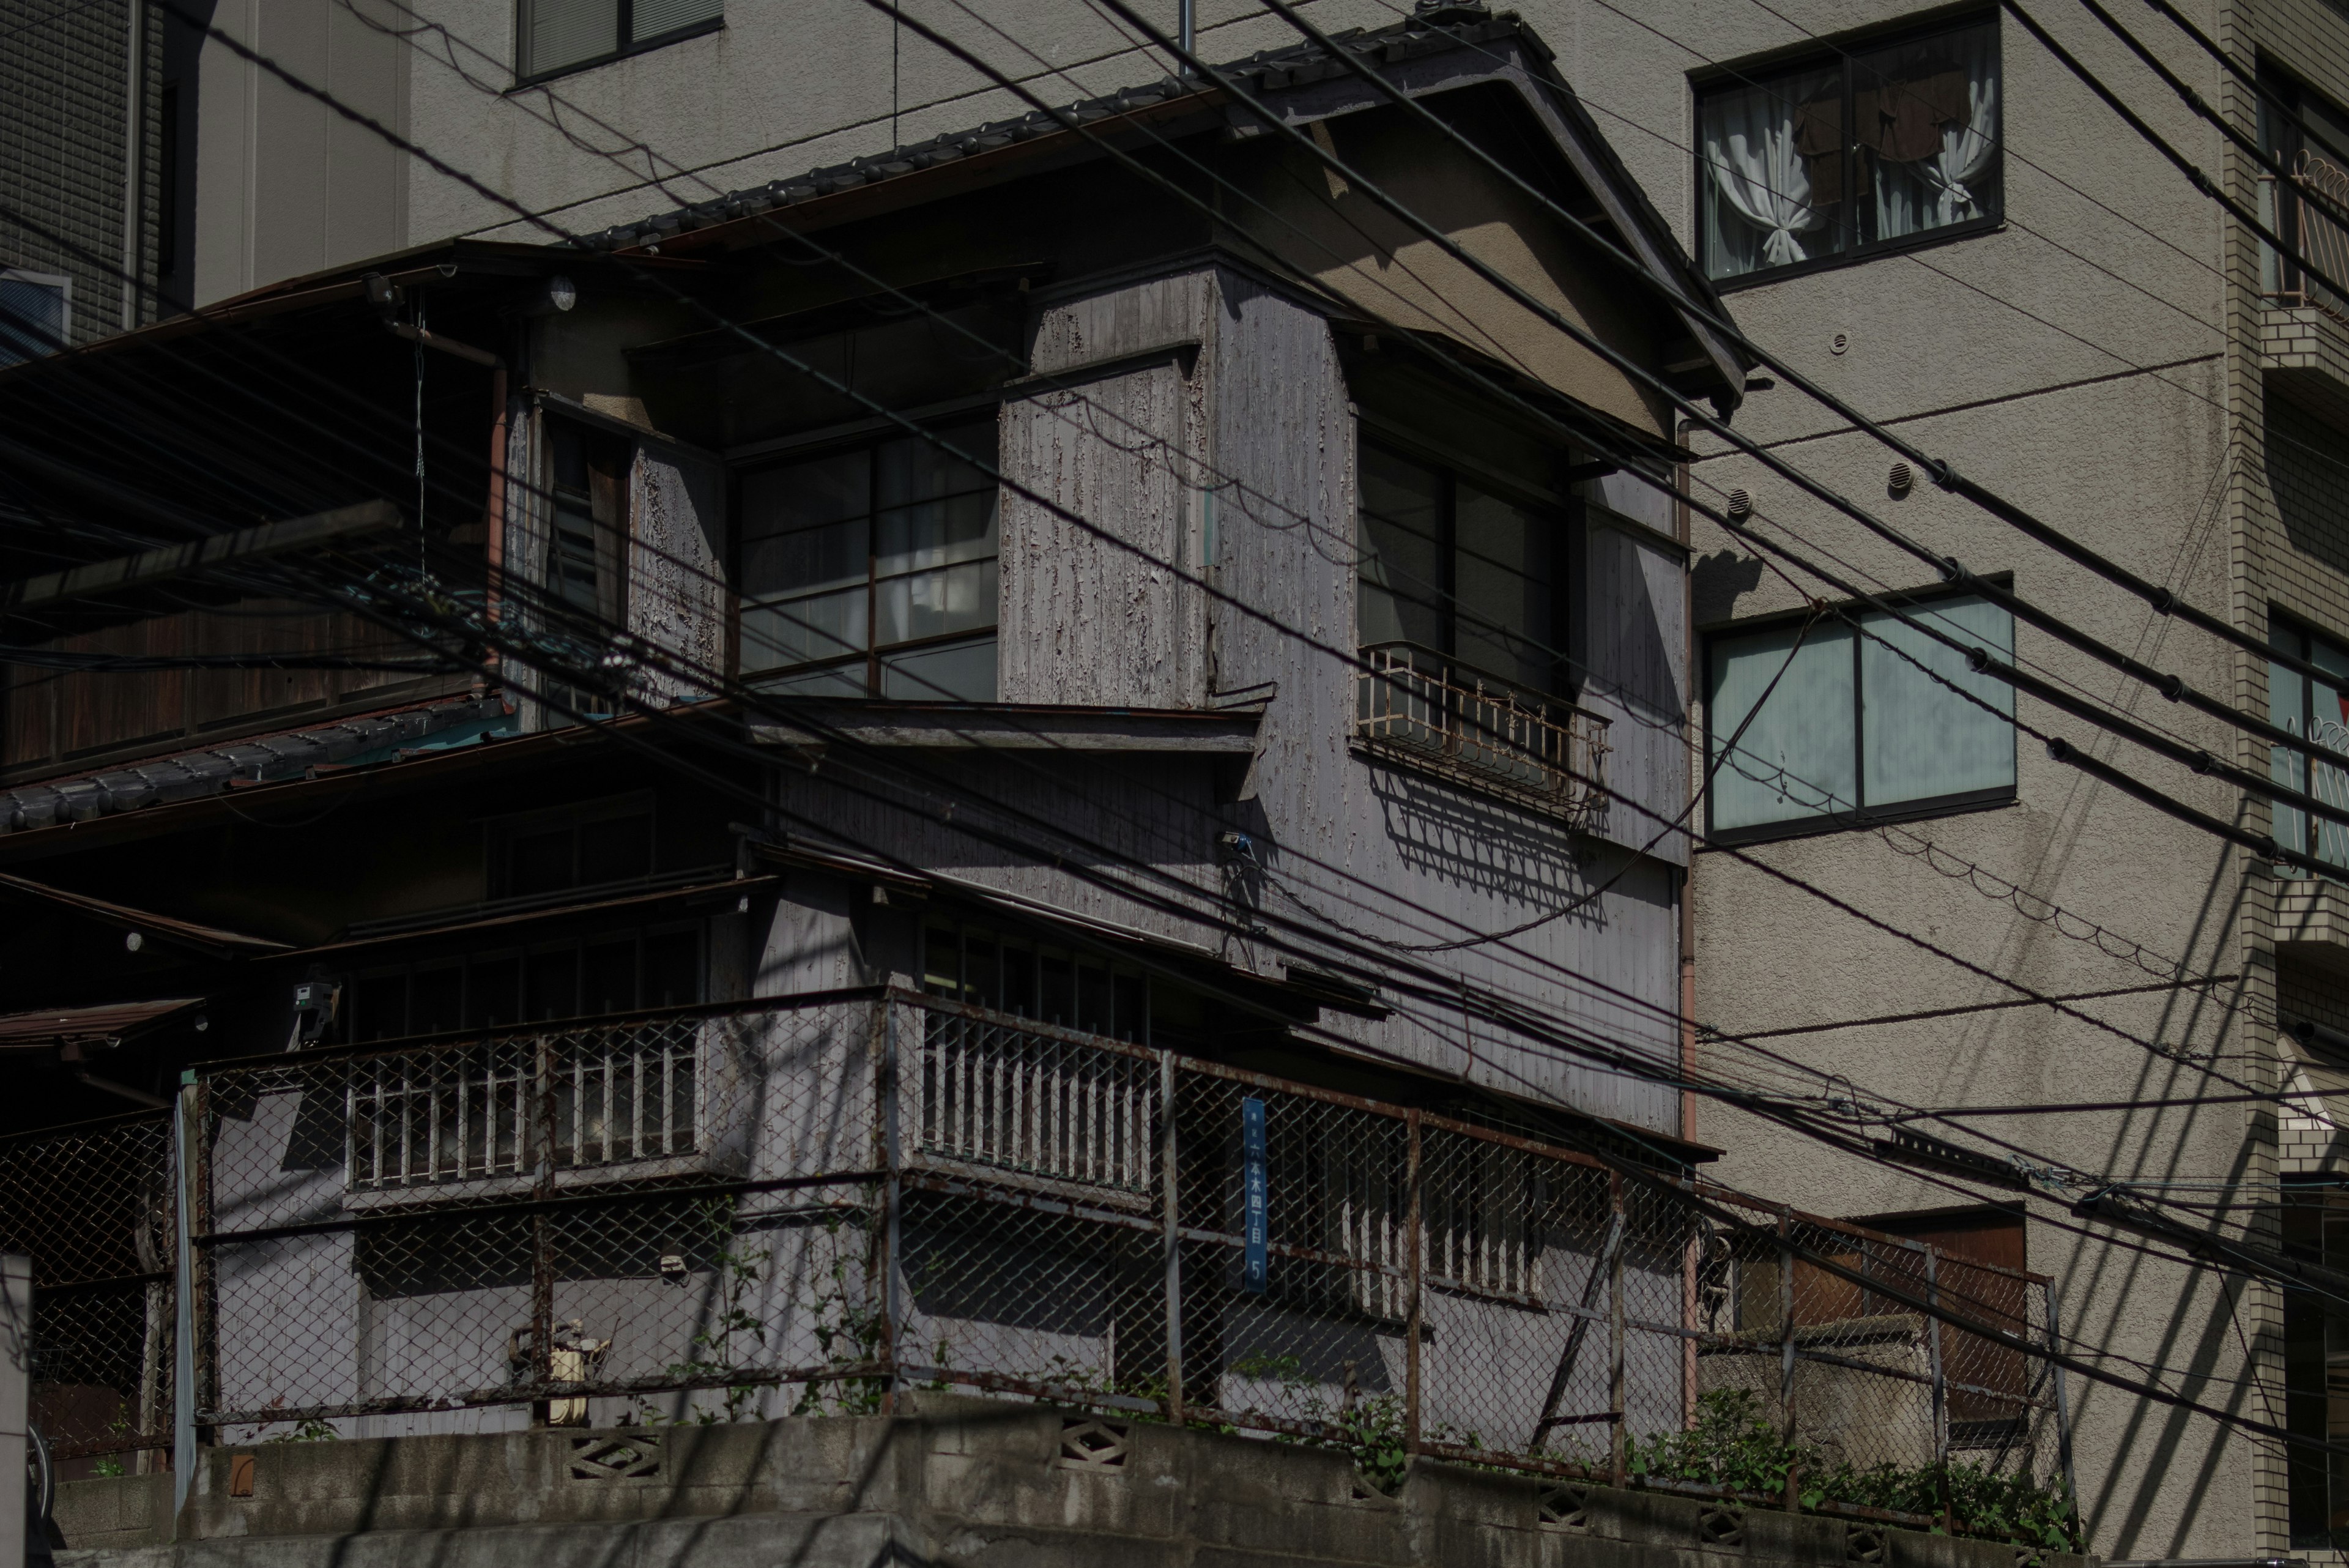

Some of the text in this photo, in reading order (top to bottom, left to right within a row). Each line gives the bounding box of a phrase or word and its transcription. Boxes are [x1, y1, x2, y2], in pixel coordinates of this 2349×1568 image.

[1250, 1143, 1262, 1244] 六本木四丁目
[1252, 1260, 1260, 1280] 5
